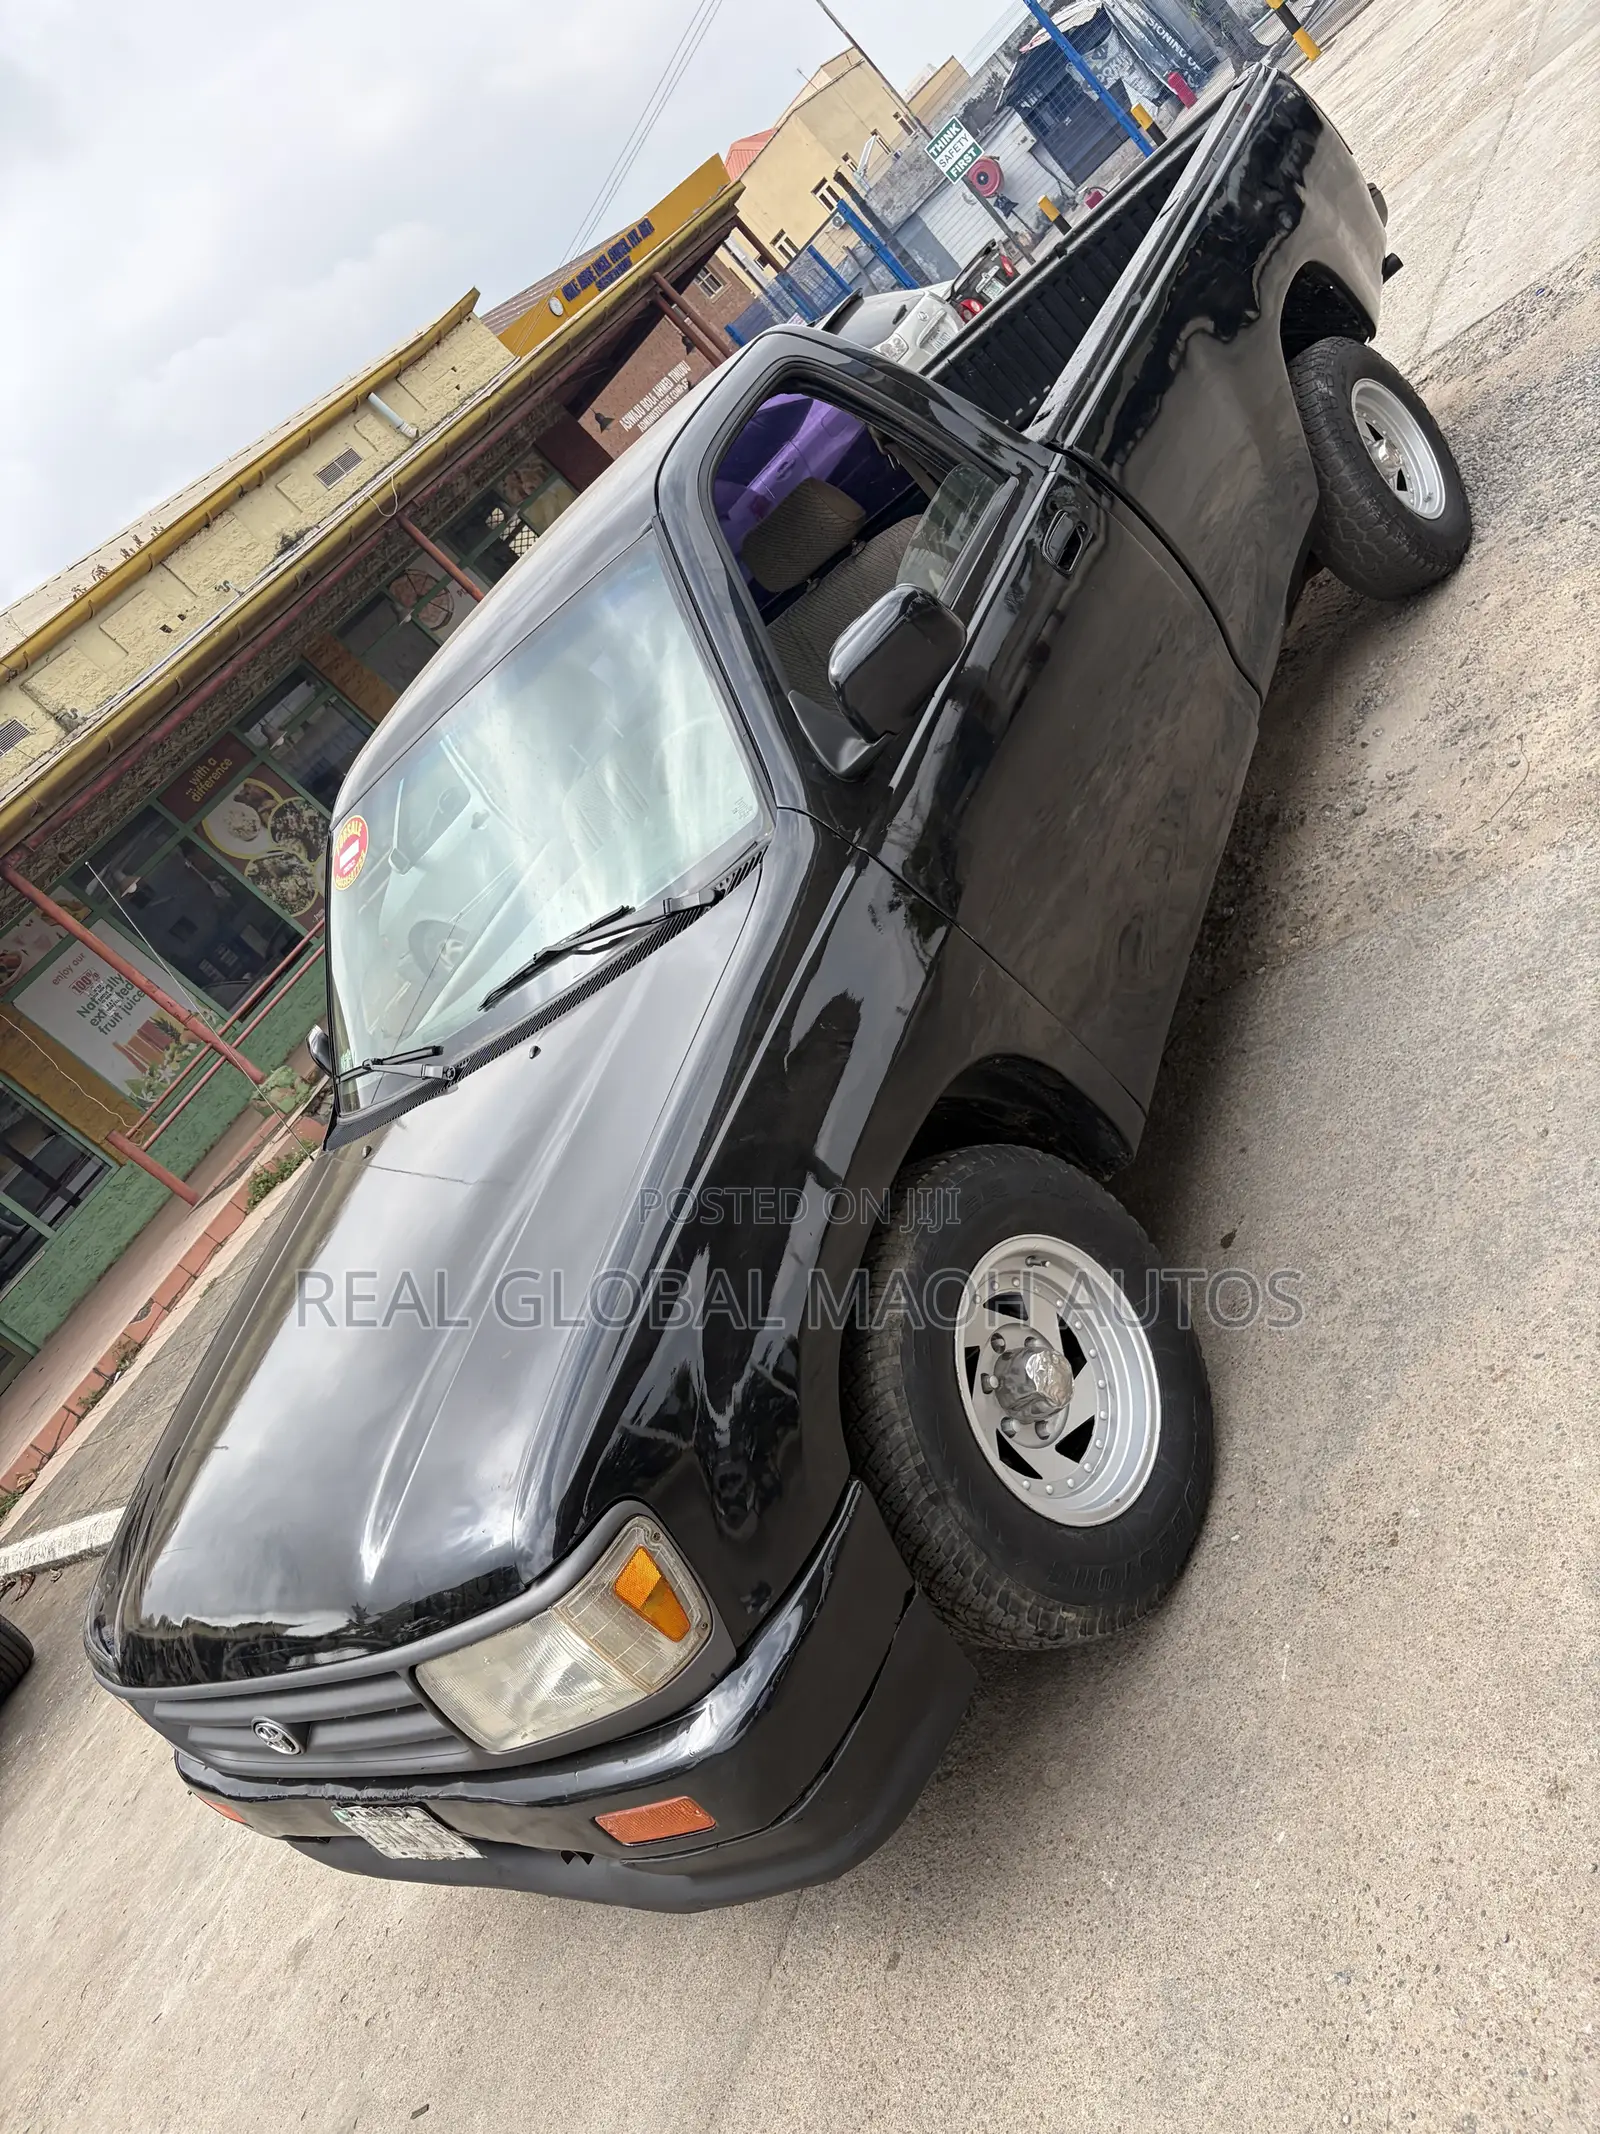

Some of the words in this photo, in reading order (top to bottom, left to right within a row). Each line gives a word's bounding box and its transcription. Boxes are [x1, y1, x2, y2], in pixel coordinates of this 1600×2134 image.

[929, 122, 962, 158] THINK
[938, 133, 969, 168] SAFETY
[950, 147, 977, 178] FIRST
[619, 403, 646, 432] ASIWAJU
[639, 392, 659, 411] BOLA
[652, 376, 673, 399] AHMED
[668, 360, 691, 383] TINUBU
[637, 395, 674, 432] ADMINISTRATIVE
[189, 765, 210, 786] with
[207, 757, 217, 766] a
[191, 758, 232, 802] difference
[52, 964, 74, 986] enjoy
[72, 970, 100, 994] 100%
[76, 973, 124, 1018] Natally
[90, 980, 134, 1026] extted
[98, 1012, 123, 1035] fruit
[119, 990, 146, 1016] juice
